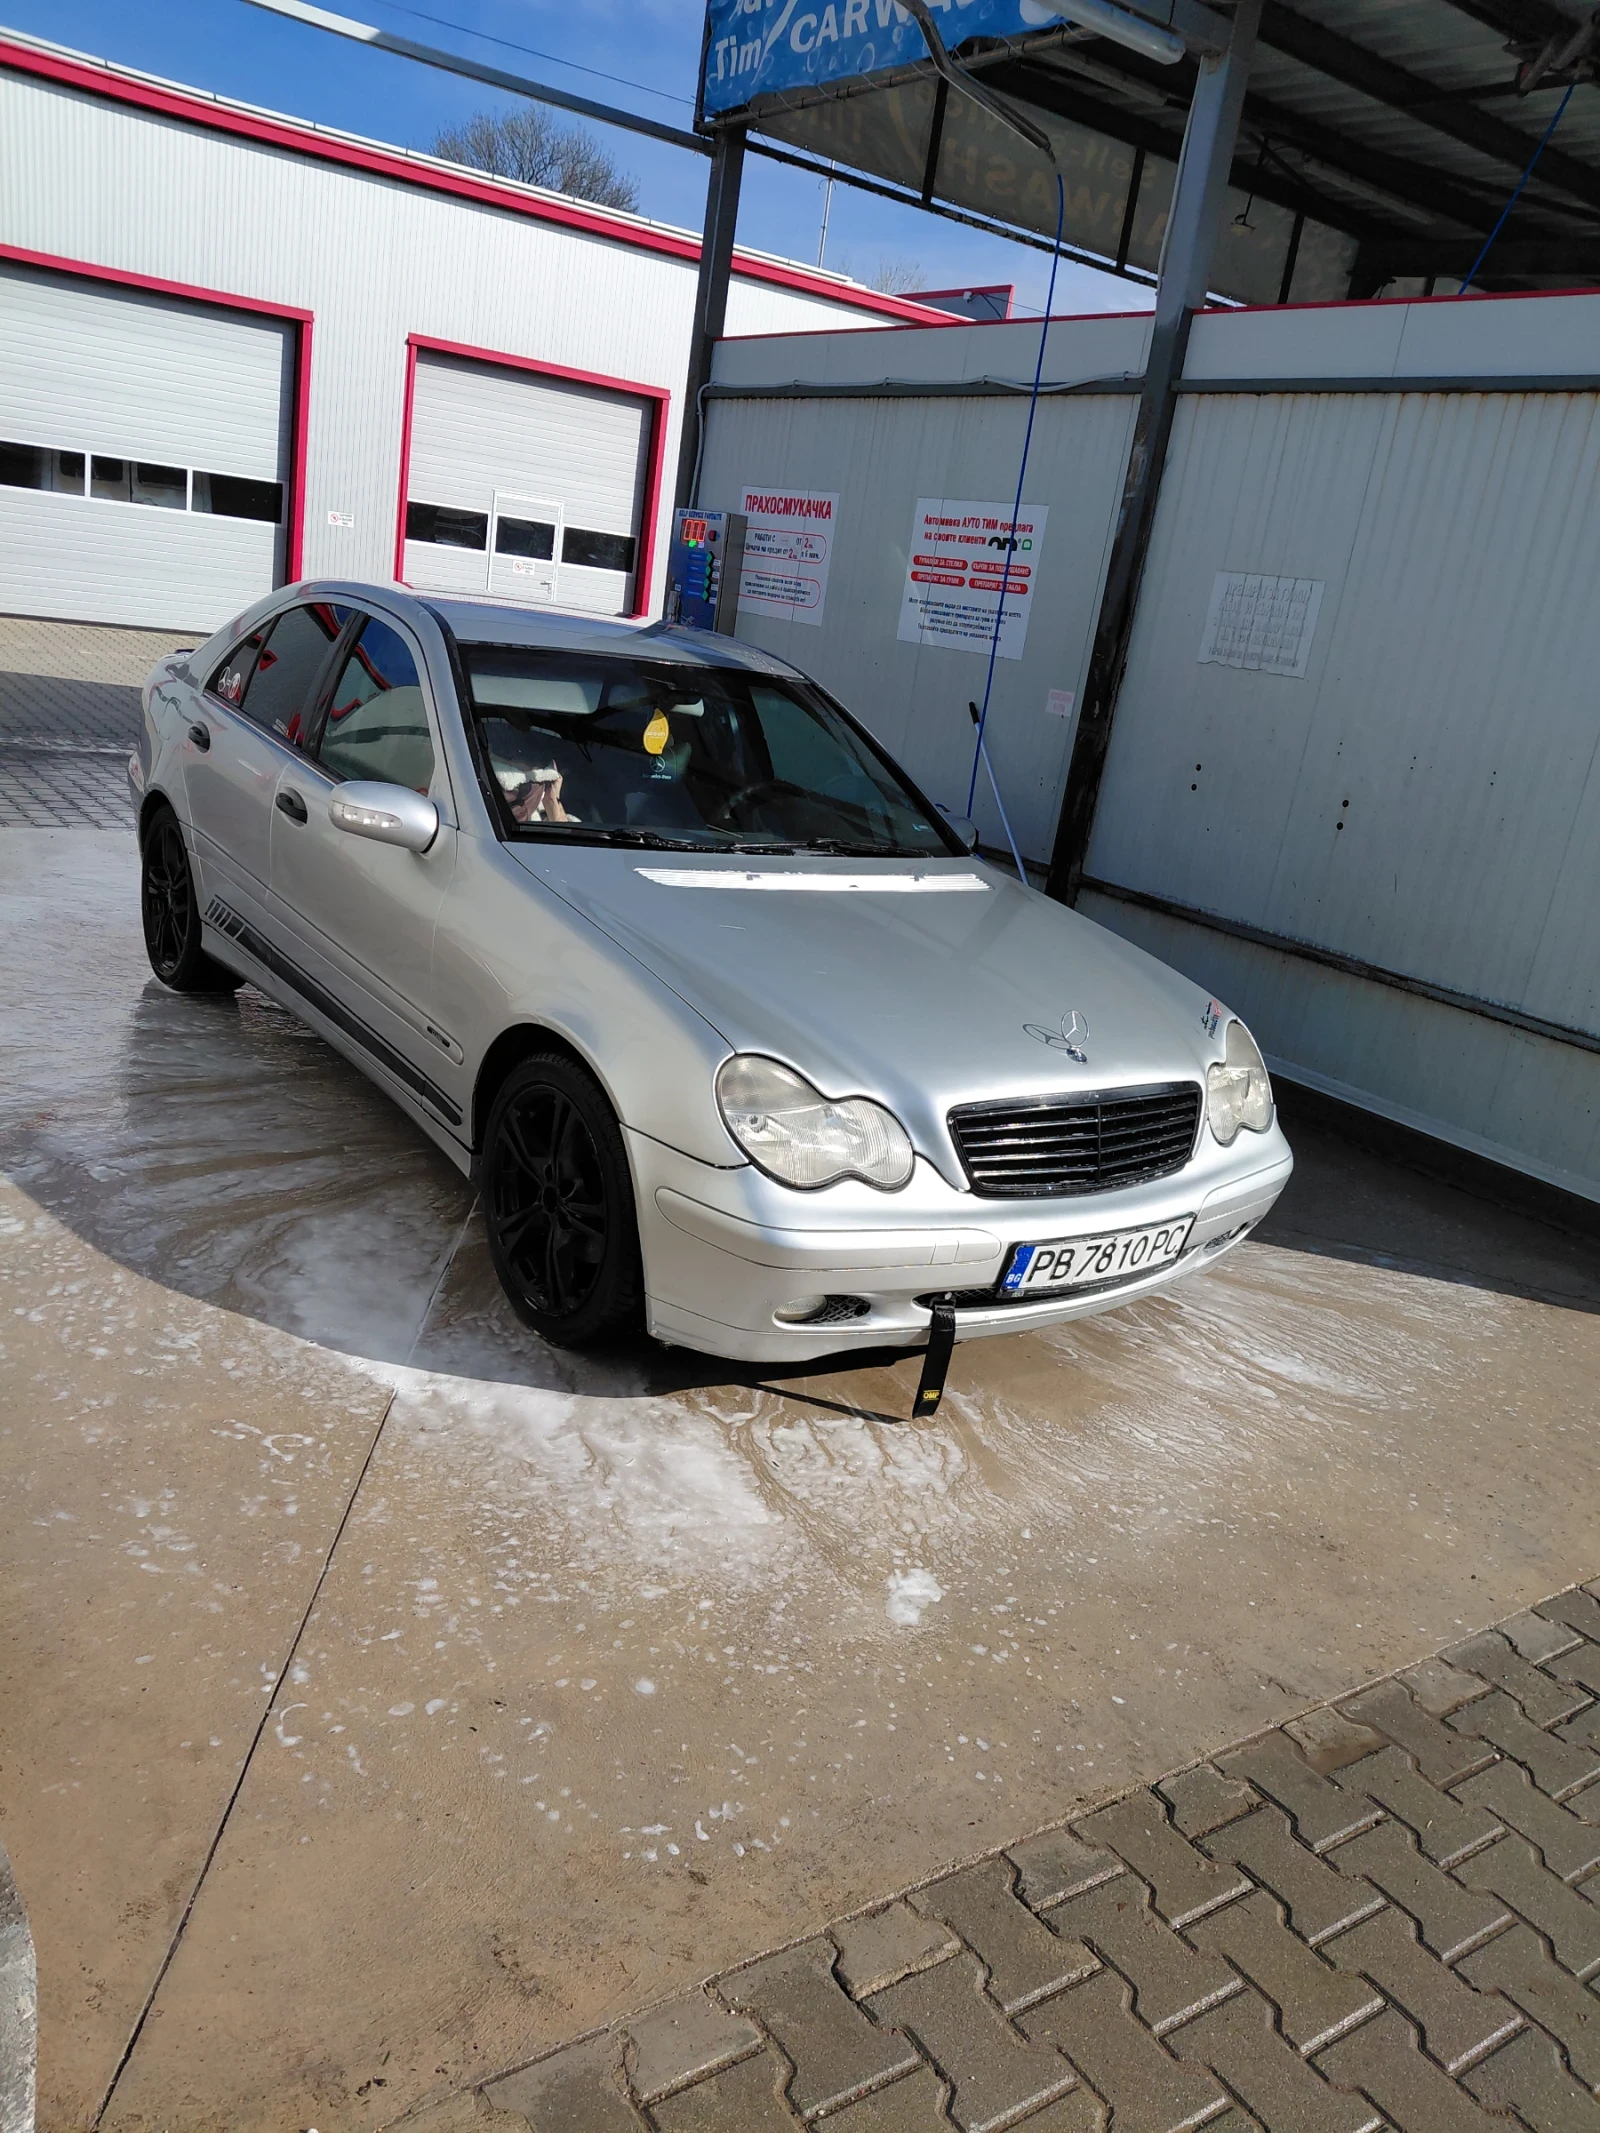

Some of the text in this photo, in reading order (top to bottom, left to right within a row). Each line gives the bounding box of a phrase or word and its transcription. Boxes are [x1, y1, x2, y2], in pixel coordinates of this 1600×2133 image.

[715, 35, 762, 80] Tim
[744, 494, 832, 519] ПРАХОСМУКАЧКА
[923, 513, 961, 527] Автомивка
[961, 517, 980, 528] АУТО
[981, 518, 998, 530] ТИМ
[754, 532, 771, 542] РАБОТИ
[923, 531, 986, 545] на своите клиенти
[994, 564, 1029, 575] ПОДУШАВАНЕ
[1006, 1273, 1022, 1284] BG
[922, 1391, 940, 1400] OMP
